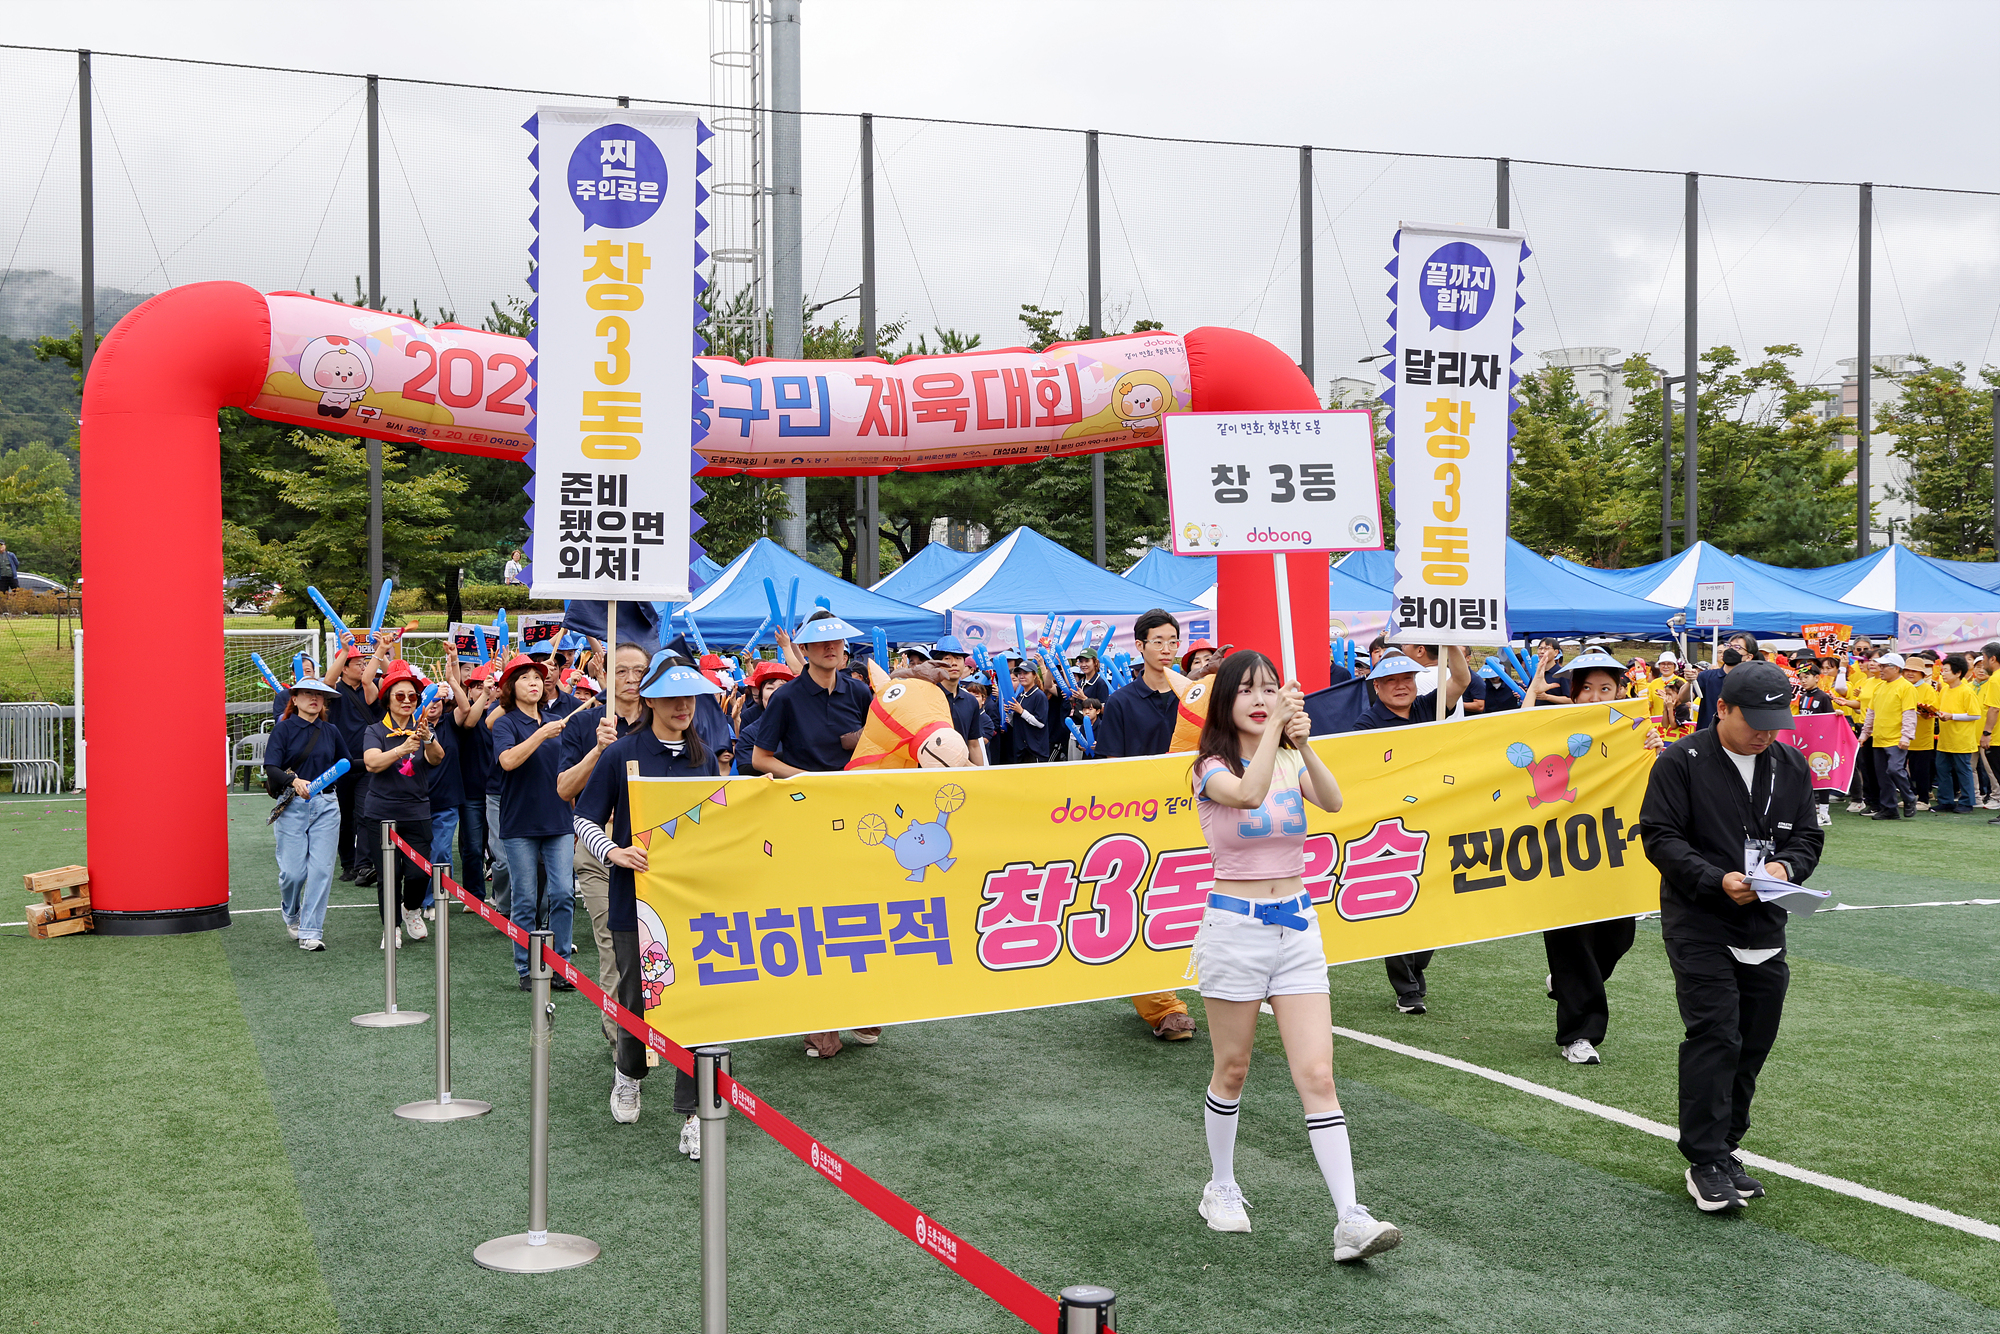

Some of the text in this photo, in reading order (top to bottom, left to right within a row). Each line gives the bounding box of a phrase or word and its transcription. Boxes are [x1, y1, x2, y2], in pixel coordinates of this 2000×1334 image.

[600, 139, 636, 176] 찐
[576, 179, 659, 203] 주인공은
[1426, 261, 1491, 291] 끝까지
[1437, 288, 1478, 316] 함께
[579, 239, 651, 460] 창3동
[1404, 347, 1502, 391] 달리자
[402, 340, 1083, 438] 202 구민 체육대회
[406, 426, 428, 437] 2025.
[445, 431, 464, 441] 20.
[468, 432, 488, 442] (토)
[489, 437, 520, 447] 09:00
[1217, 419, 1322, 436] 같이 변화, 행복한 도봉
[560, 472, 628, 508] 준비
[1211, 463, 1337, 504] 창 3동
[1420, 397, 1476, 587] 창3동
[559, 509, 664, 547] 됐으면
[1246, 527, 1312, 545] dobong
[557, 546, 640, 582] 외쳐!
[1398, 595, 1499, 631] 화이팅!
[1700, 598, 1730, 612] 방학 2동
[538, 626, 547, 639] 3
[669, 671, 700, 681] 창3동
[1050, 795, 1159, 824] dobong
[1164, 796, 1192, 816] 같이
[1237, 787, 1308, 839] 33
[688, 896, 953, 987] 천하무적
[976, 833, 1215, 972] 창3동
[927, 1225, 957, 1257] 도봉구체육회
